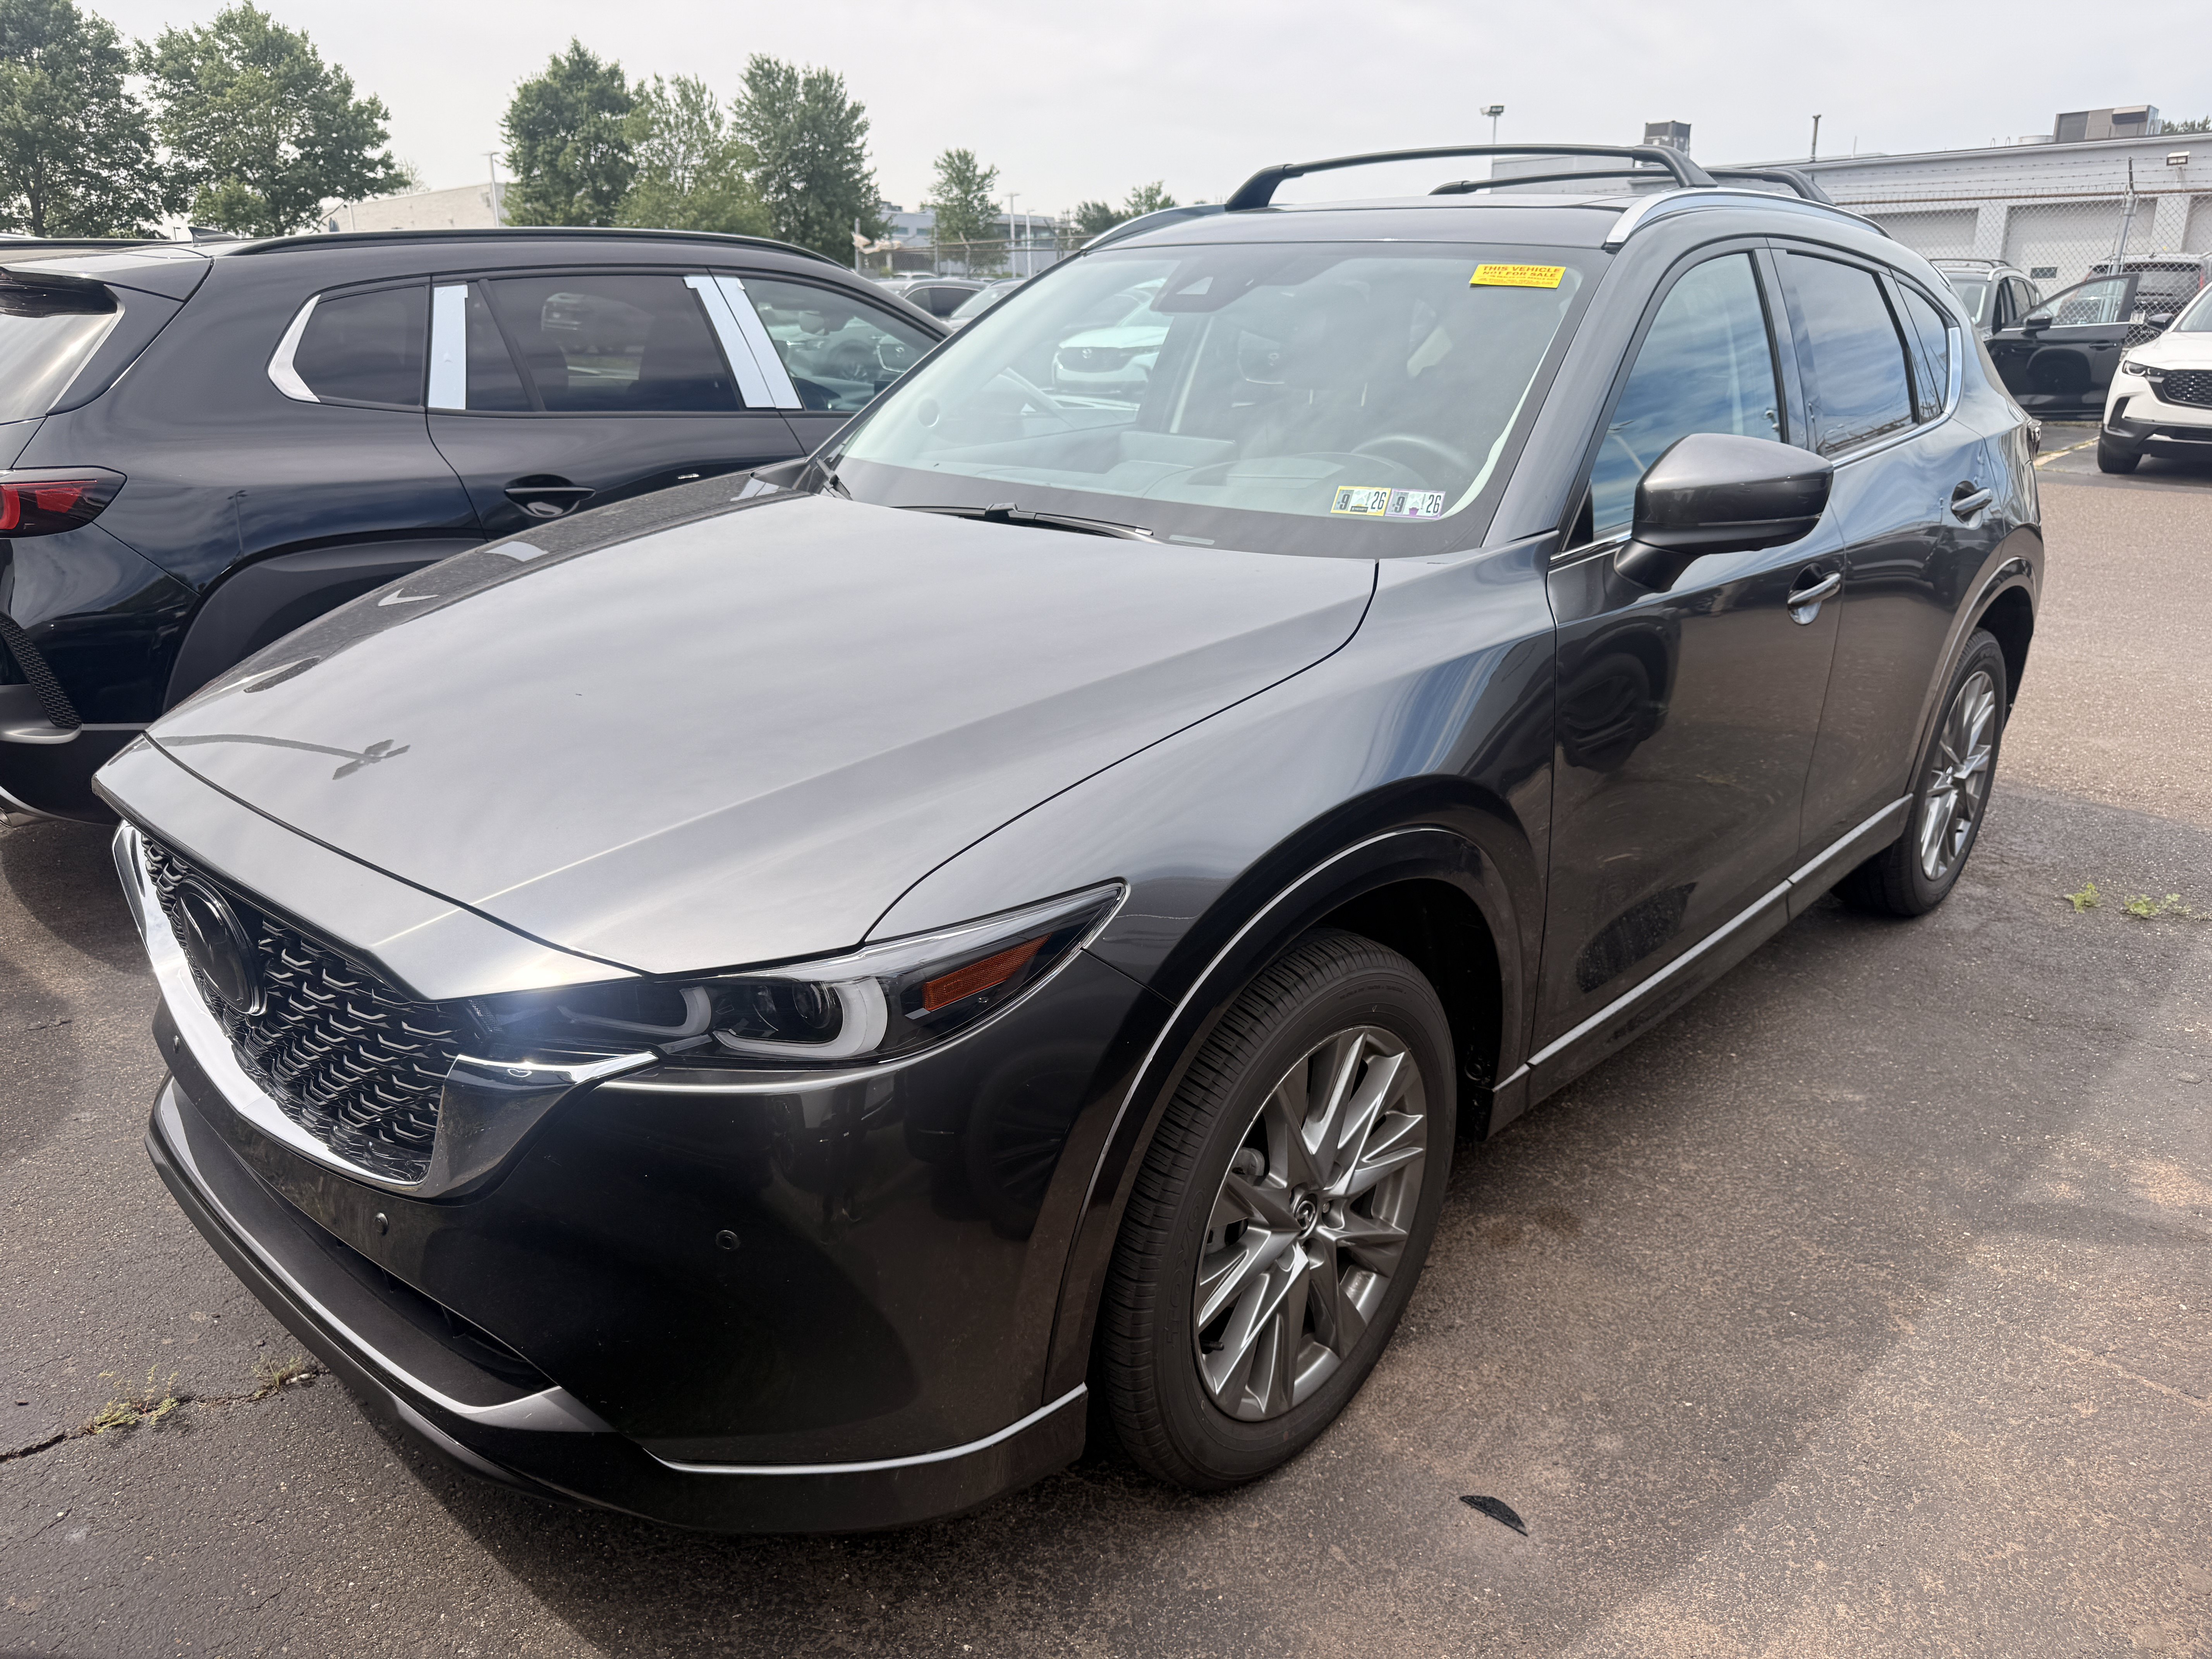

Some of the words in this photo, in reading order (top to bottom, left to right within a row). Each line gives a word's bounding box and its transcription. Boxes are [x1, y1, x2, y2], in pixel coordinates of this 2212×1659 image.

[1339, 494, 1350, 510] 9
[1370, 491, 1387, 510] 26
[1394, 496, 1405, 513] 9
[1426, 495, 1441, 514] 26
[1166, 1189, 1204, 1343] TOYO
